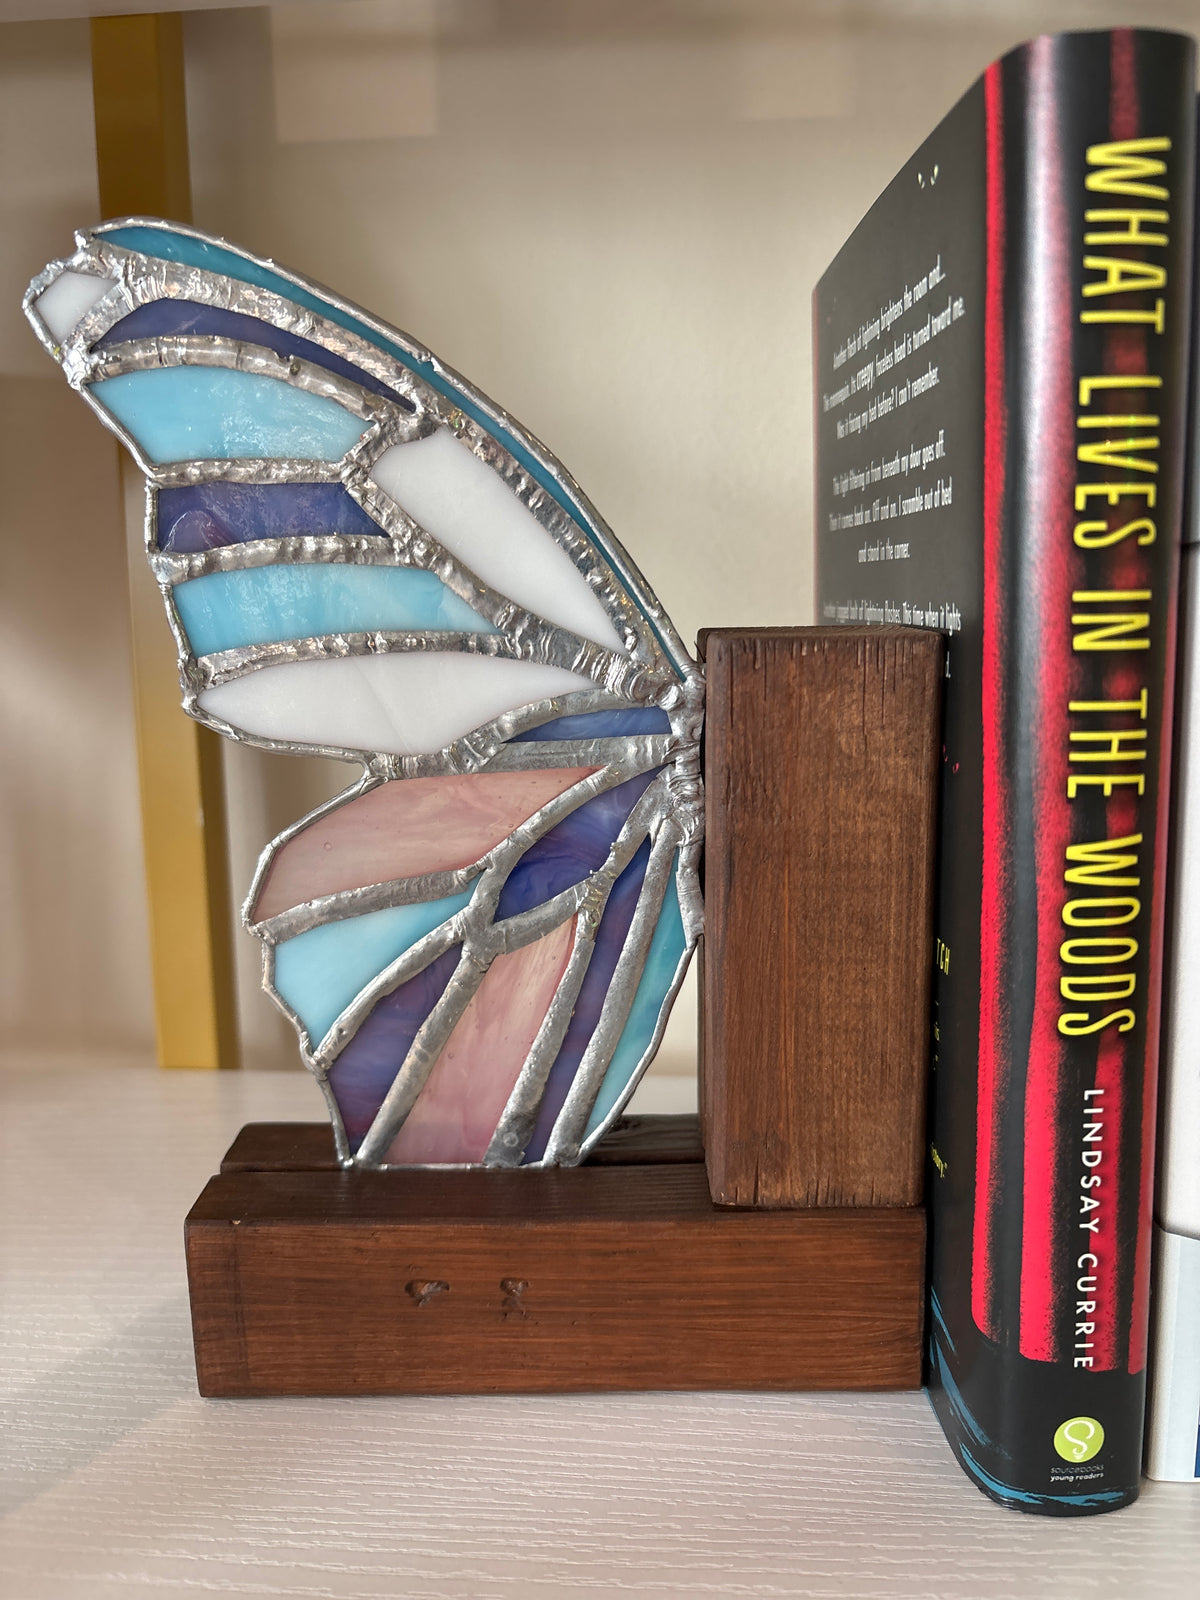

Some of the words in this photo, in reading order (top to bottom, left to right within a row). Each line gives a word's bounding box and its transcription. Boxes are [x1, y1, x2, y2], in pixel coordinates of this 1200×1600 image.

[1081, 137, 1170, 333] WHAT
[903, 285, 912, 312] the
[914, 276, 927, 303] room
[913, 313, 930, 351] turned
[931, 296, 951, 337] toward
[910, 444, 922, 469] door
[922, 444, 934, 470] goes
[924, 488, 933, 511] out
[934, 480, 941, 508] of
[941, 476, 952, 506] bed
[1074, 375, 1161, 549] LIVES
[1071, 590, 1152, 651] IN
[1068, 688, 1148, 798] THE
[1057, 833, 1142, 1036] WOODS
[1079, 1089, 1105, 1233] LINDSAY
[1073, 1253, 1098, 1368] CURRIE
